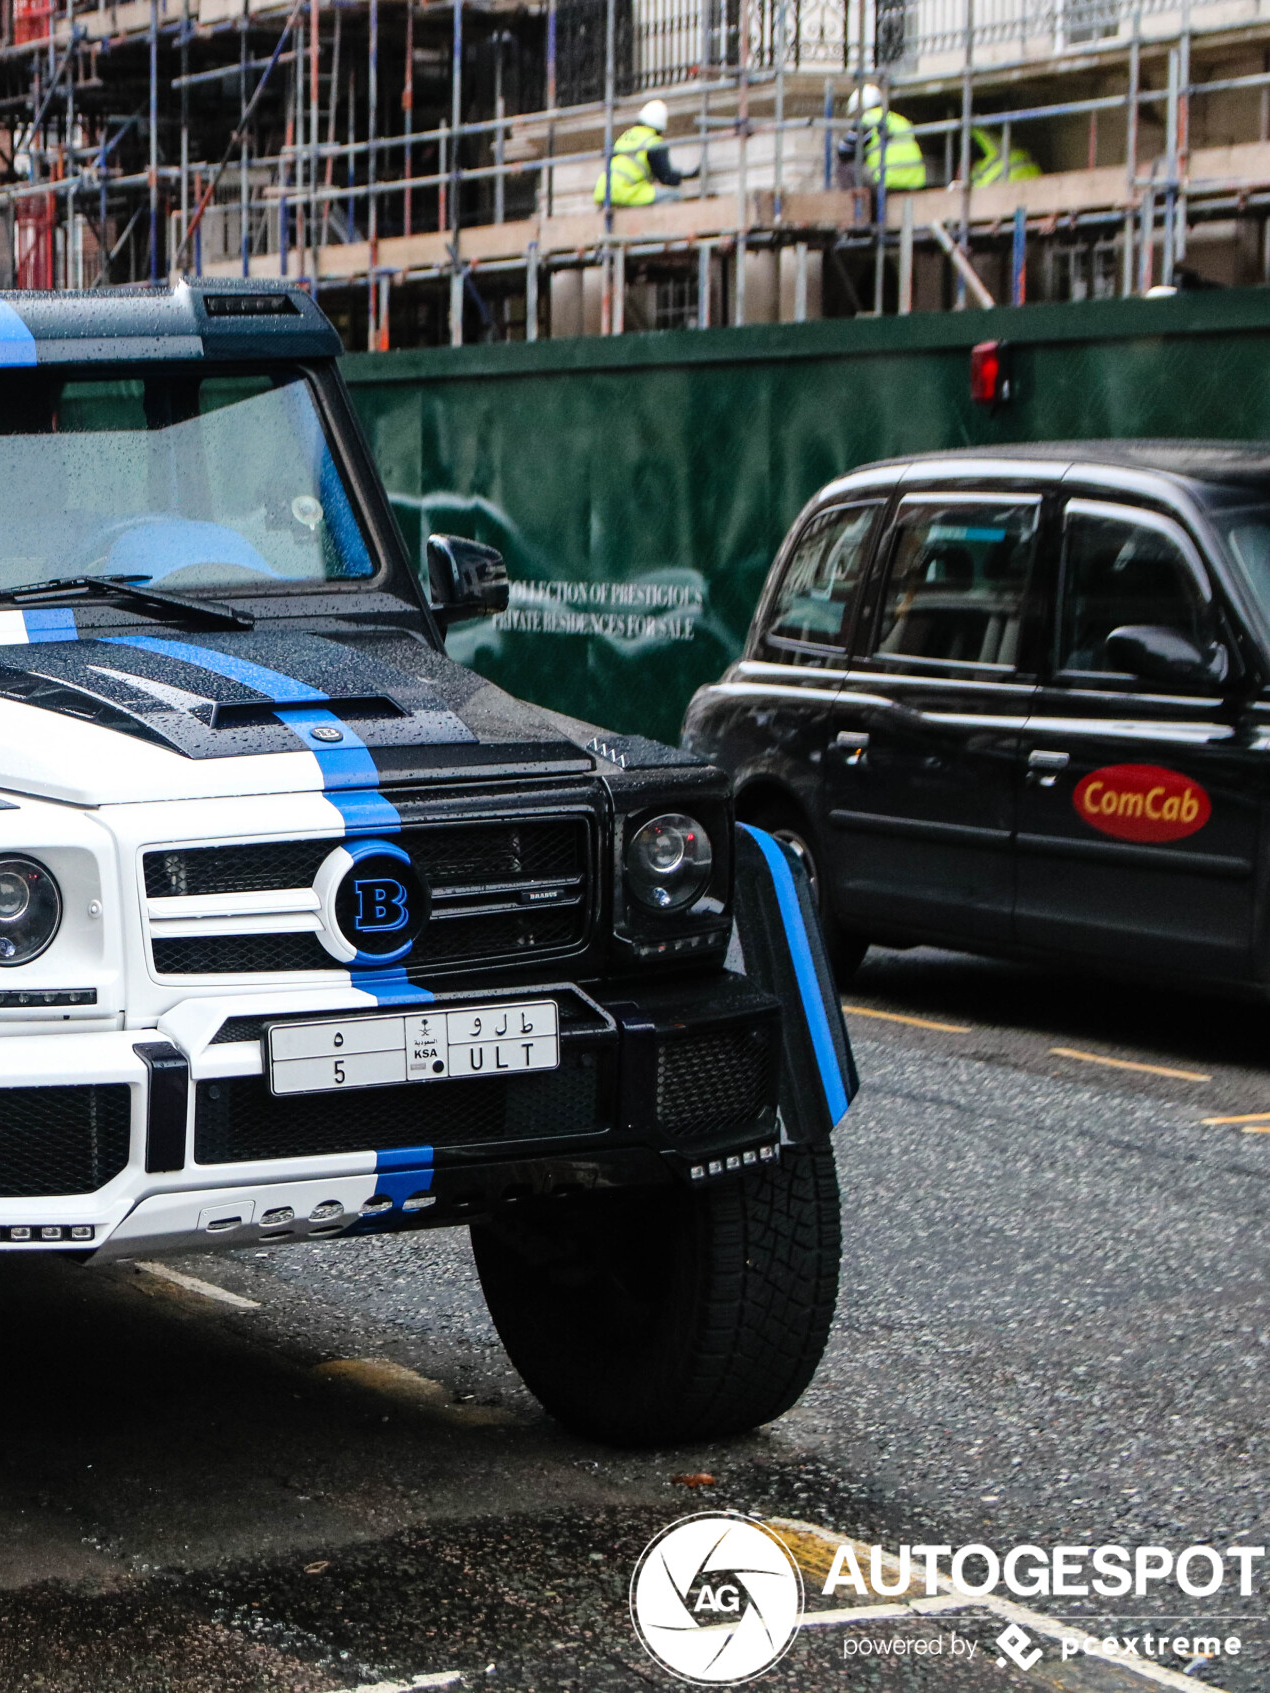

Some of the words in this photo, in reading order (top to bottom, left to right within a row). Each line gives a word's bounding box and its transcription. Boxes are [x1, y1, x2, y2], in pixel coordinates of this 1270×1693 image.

[508, 580, 588, 604] OLLECTION
[589, 583, 609, 604] OF
[492, 609, 541, 632] PRIVATE
[543, 611, 625, 635] RESIDENCES
[628, 614, 656, 638] FOR
[659, 618, 695, 640] SALE
[1084, 780, 1200, 823] ComCab
[354, 878, 410, 932] B
[414, 1048, 438, 1059] KSA
[334, 1060, 346, 1084] 5
